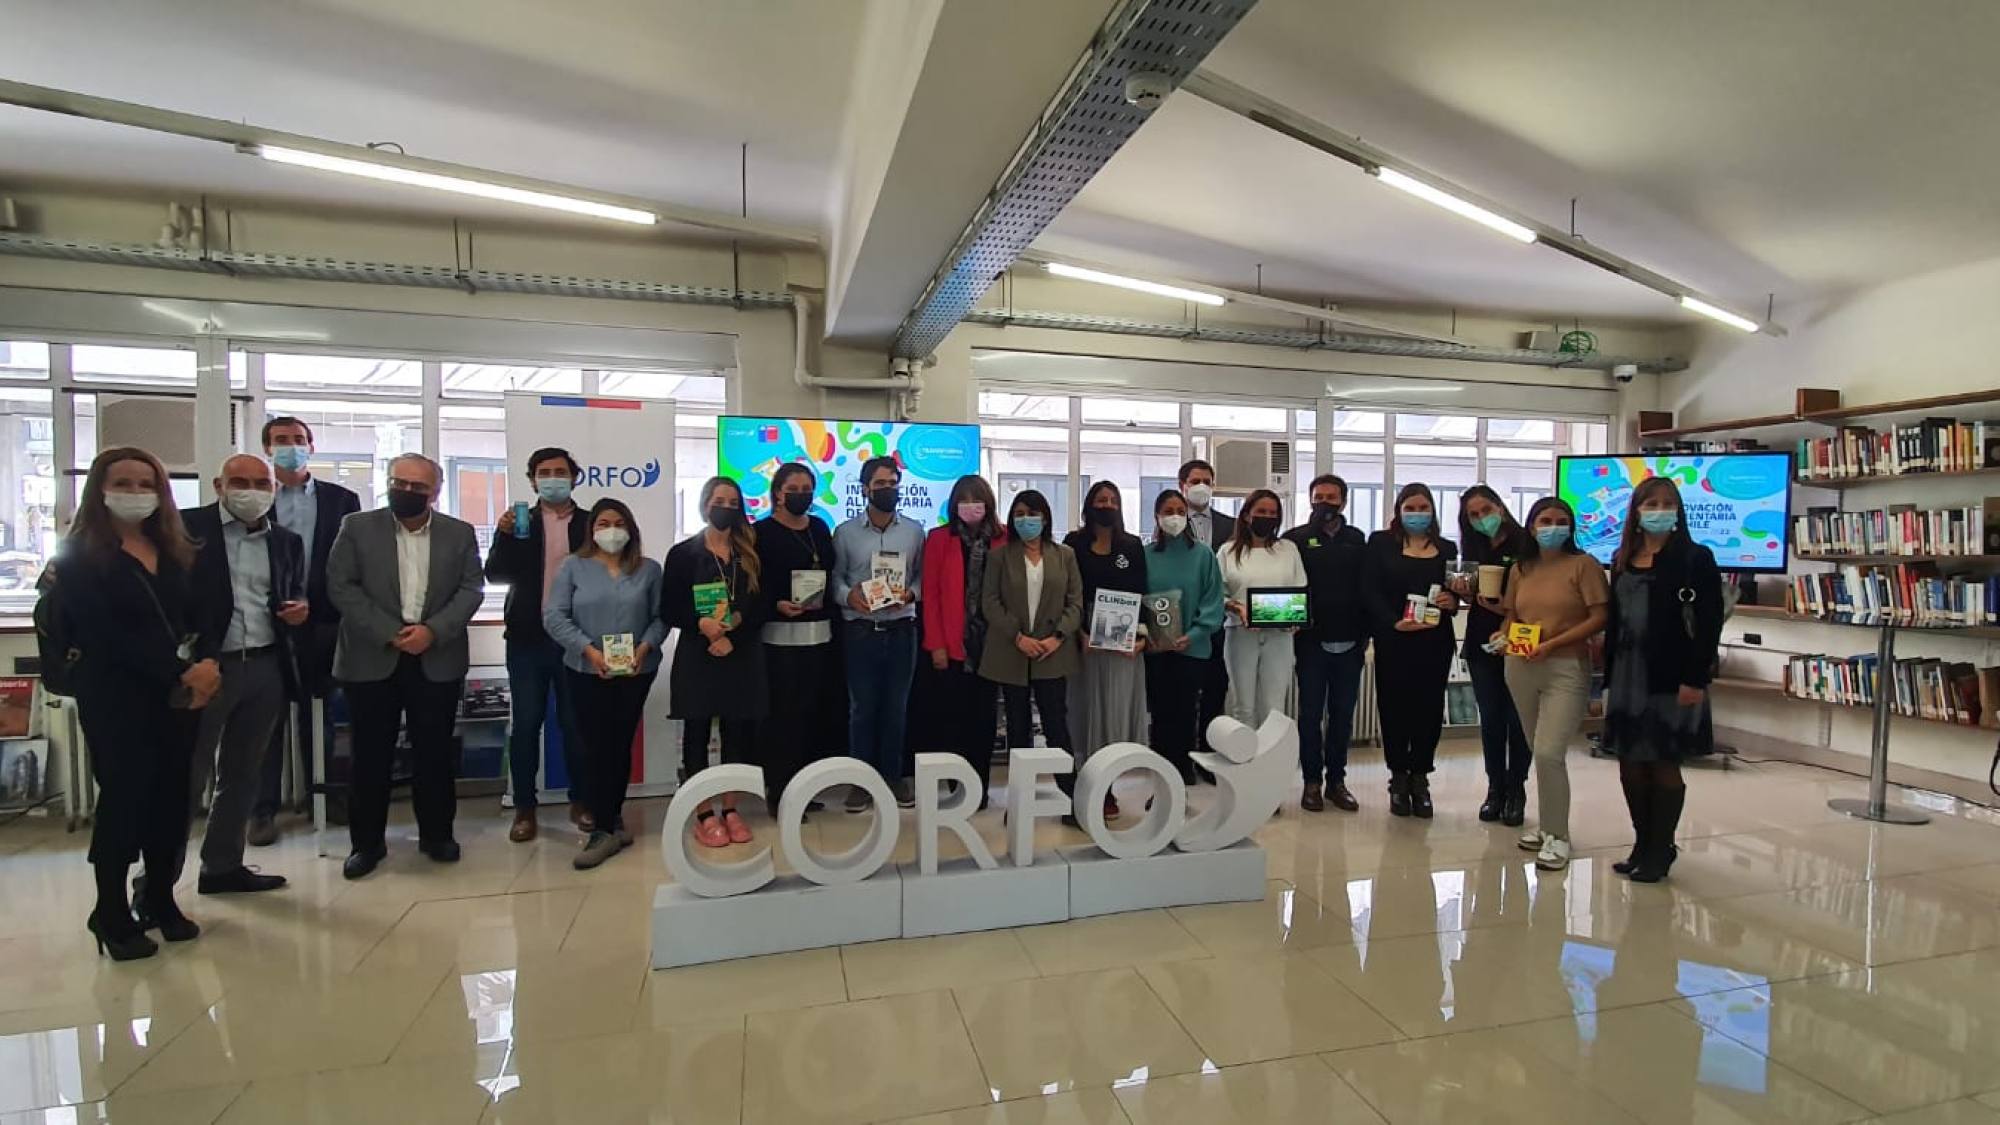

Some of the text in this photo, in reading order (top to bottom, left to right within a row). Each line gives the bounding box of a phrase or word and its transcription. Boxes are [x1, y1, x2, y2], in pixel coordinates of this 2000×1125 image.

[573, 465, 643, 488] ORFO
[1683, 502, 1734, 512] OVACIÓN
[1688, 512, 1737, 521] ENTARIA
[661, 742, 1187, 898] CORFO
